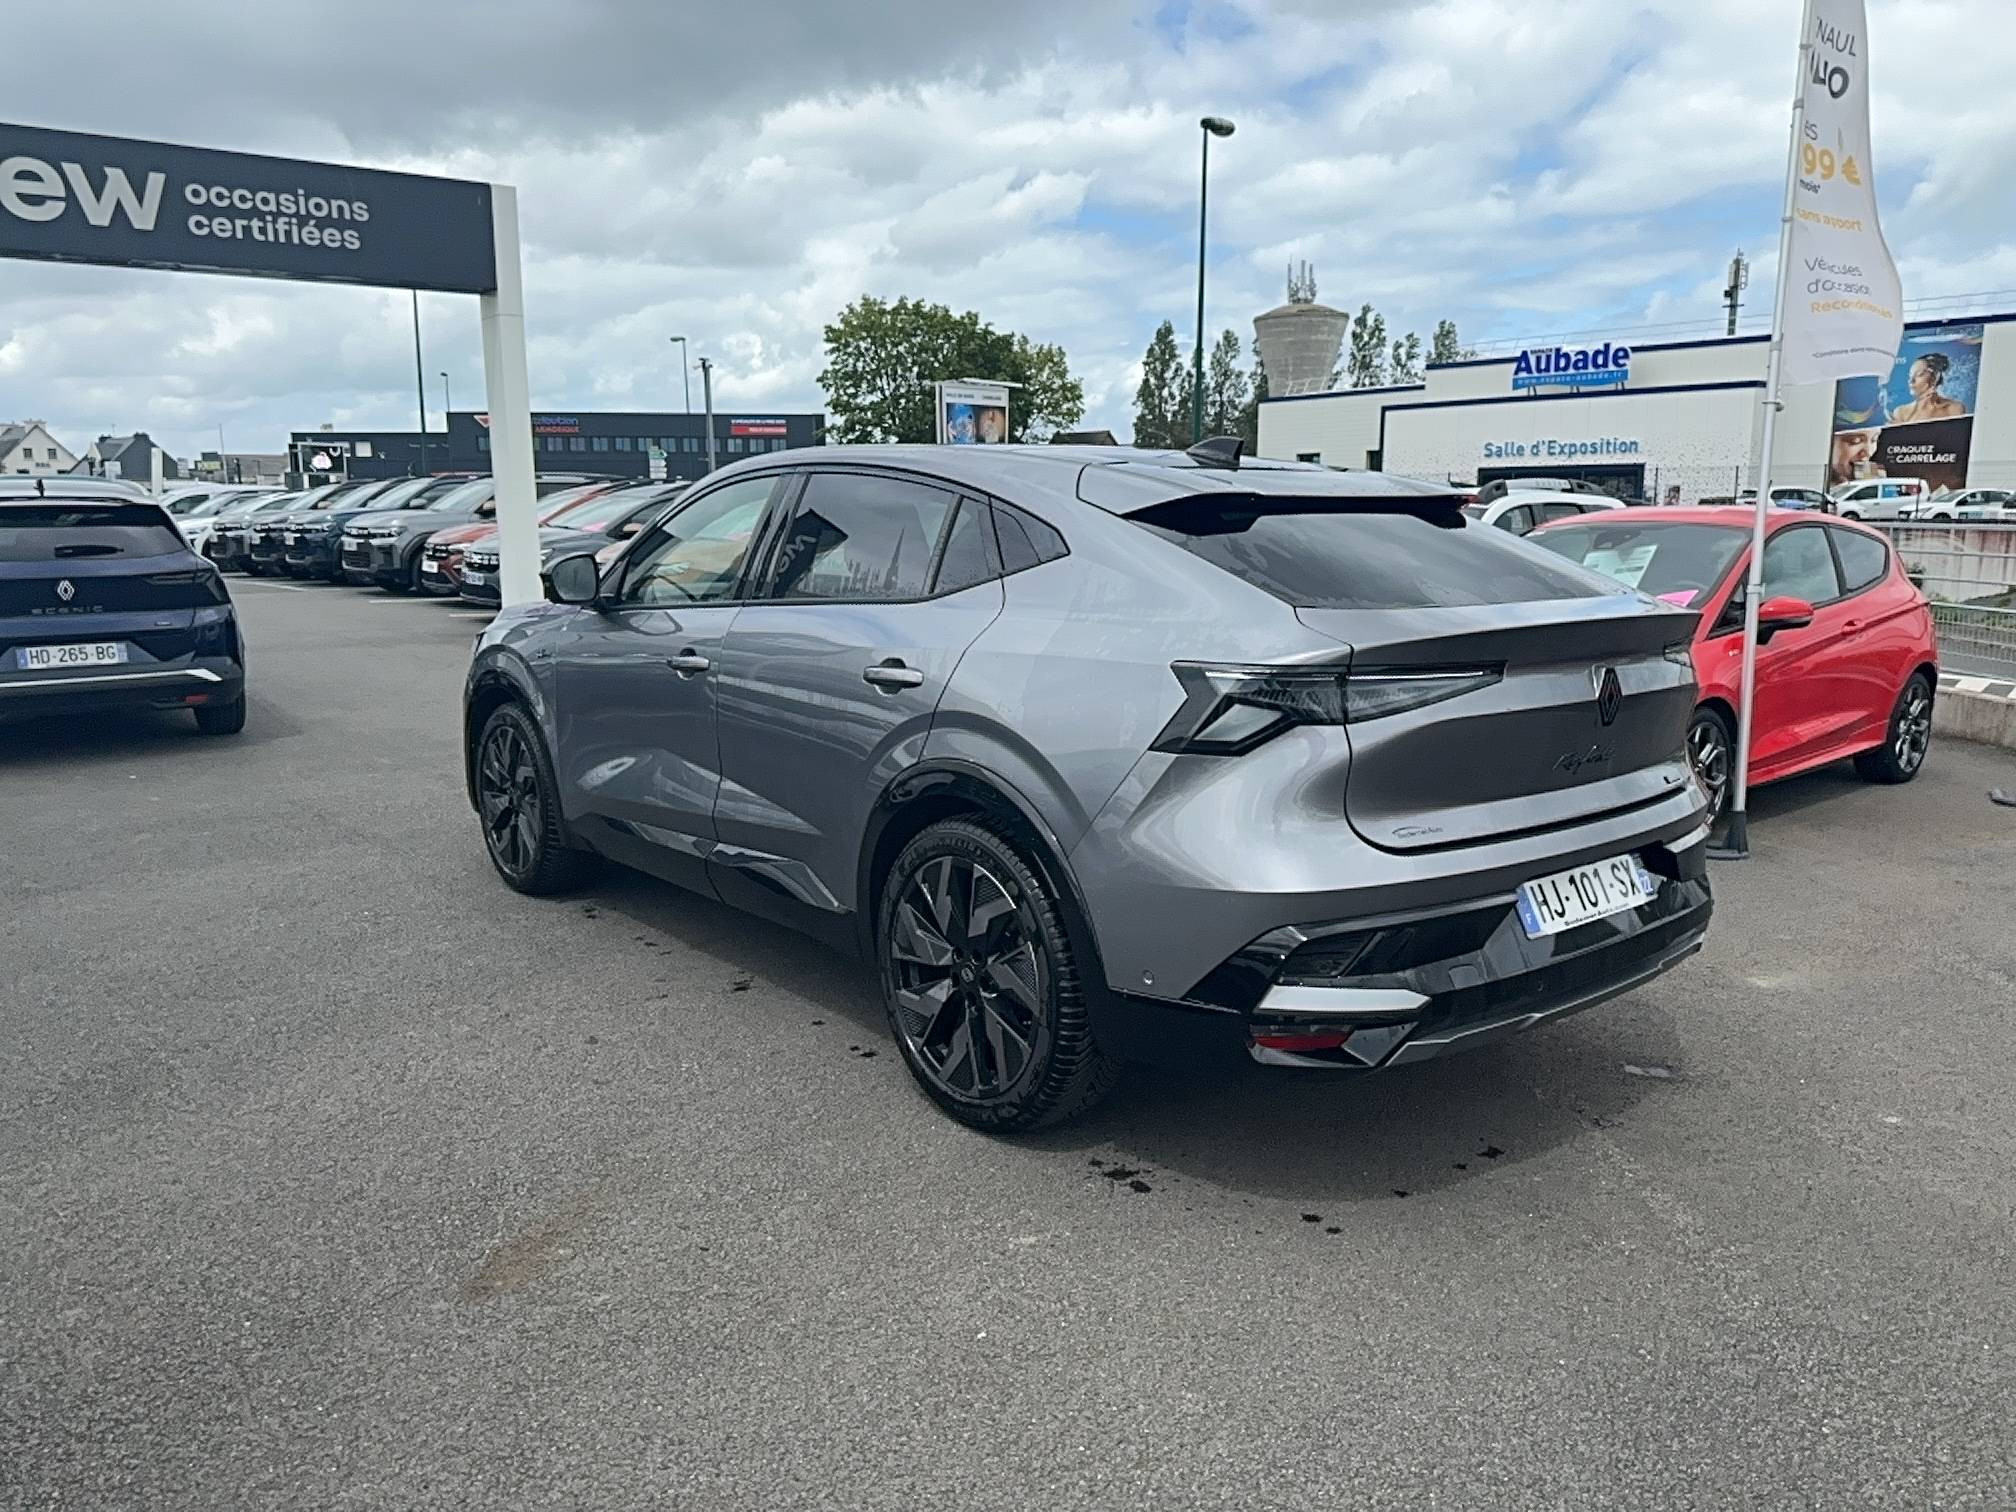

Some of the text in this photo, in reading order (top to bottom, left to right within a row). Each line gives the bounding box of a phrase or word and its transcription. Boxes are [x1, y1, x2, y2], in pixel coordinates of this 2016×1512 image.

[1803, 143, 1862, 186] 99 €
[185, 182, 370, 222] occasions
[188, 212, 361, 250] certifiées
[1513, 342, 1630, 376] Aubade
[1484, 438, 1639, 458] Salle d'Exposition
[1887, 445, 1935, 454] CRAQUEZ
[1896, 453, 1957, 463] CARRELAGE
